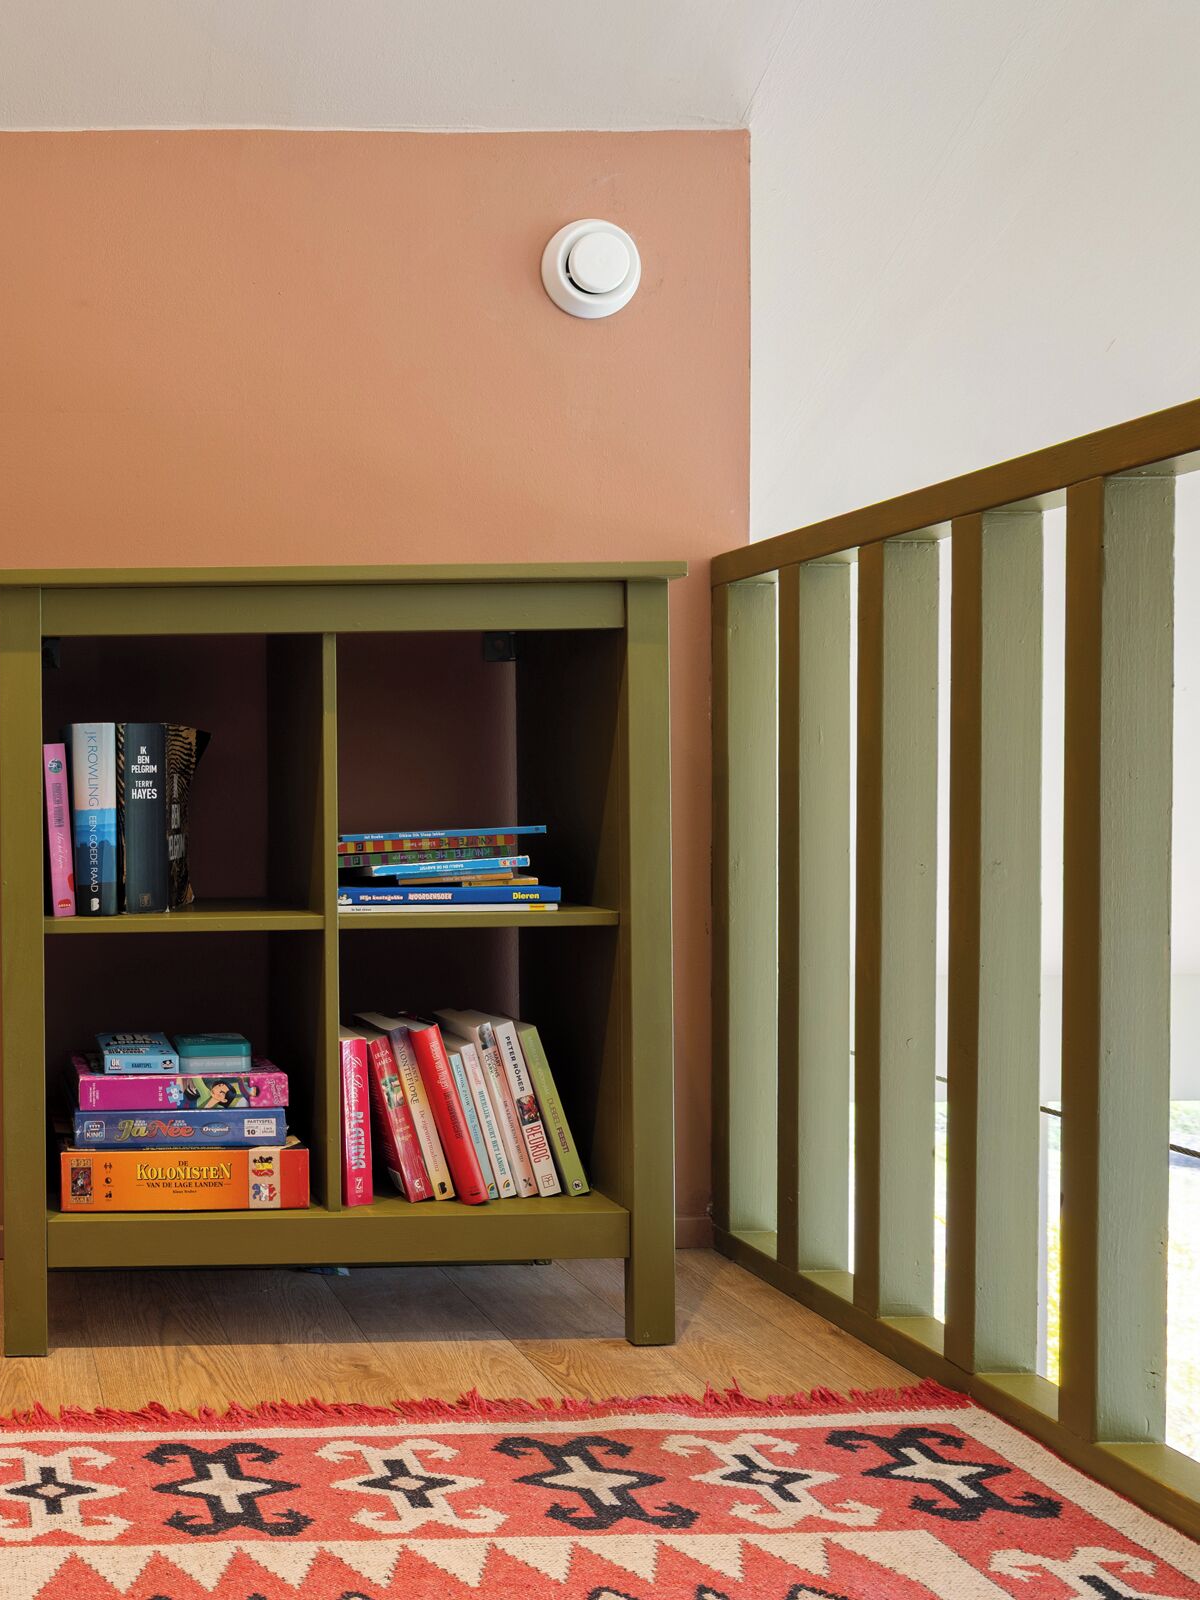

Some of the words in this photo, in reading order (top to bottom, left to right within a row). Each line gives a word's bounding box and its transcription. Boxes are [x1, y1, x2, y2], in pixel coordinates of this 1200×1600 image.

[137, 755, 150, 764] BEN
[140, 746, 147, 755] IK
[88, 745, 99, 807] ROWLING
[131, 765, 158, 773] PELGRIM
[131, 788, 158, 799] HAYES
[89, 816, 97, 832] EEN
[89, 834, 98, 865] GOEDE
[90, 867, 99, 893] RAAD
[398, 1044, 420, 1105] MONTEFIORE
[505, 1036, 517, 1062] PETER
[513, 1062, 525, 1092] RÖMER
[546, 1097, 561, 1127] DUBBEL
[86, 1130, 103, 1138] KING
[146, 1120, 195, 1137] Nee
[351, 1111, 366, 1170] PLATINA
[525, 1124, 550, 1164] BEDROG
[136, 1162, 232, 1180] KOLONISTEN
[495, 1150, 506, 1176] LANGST
